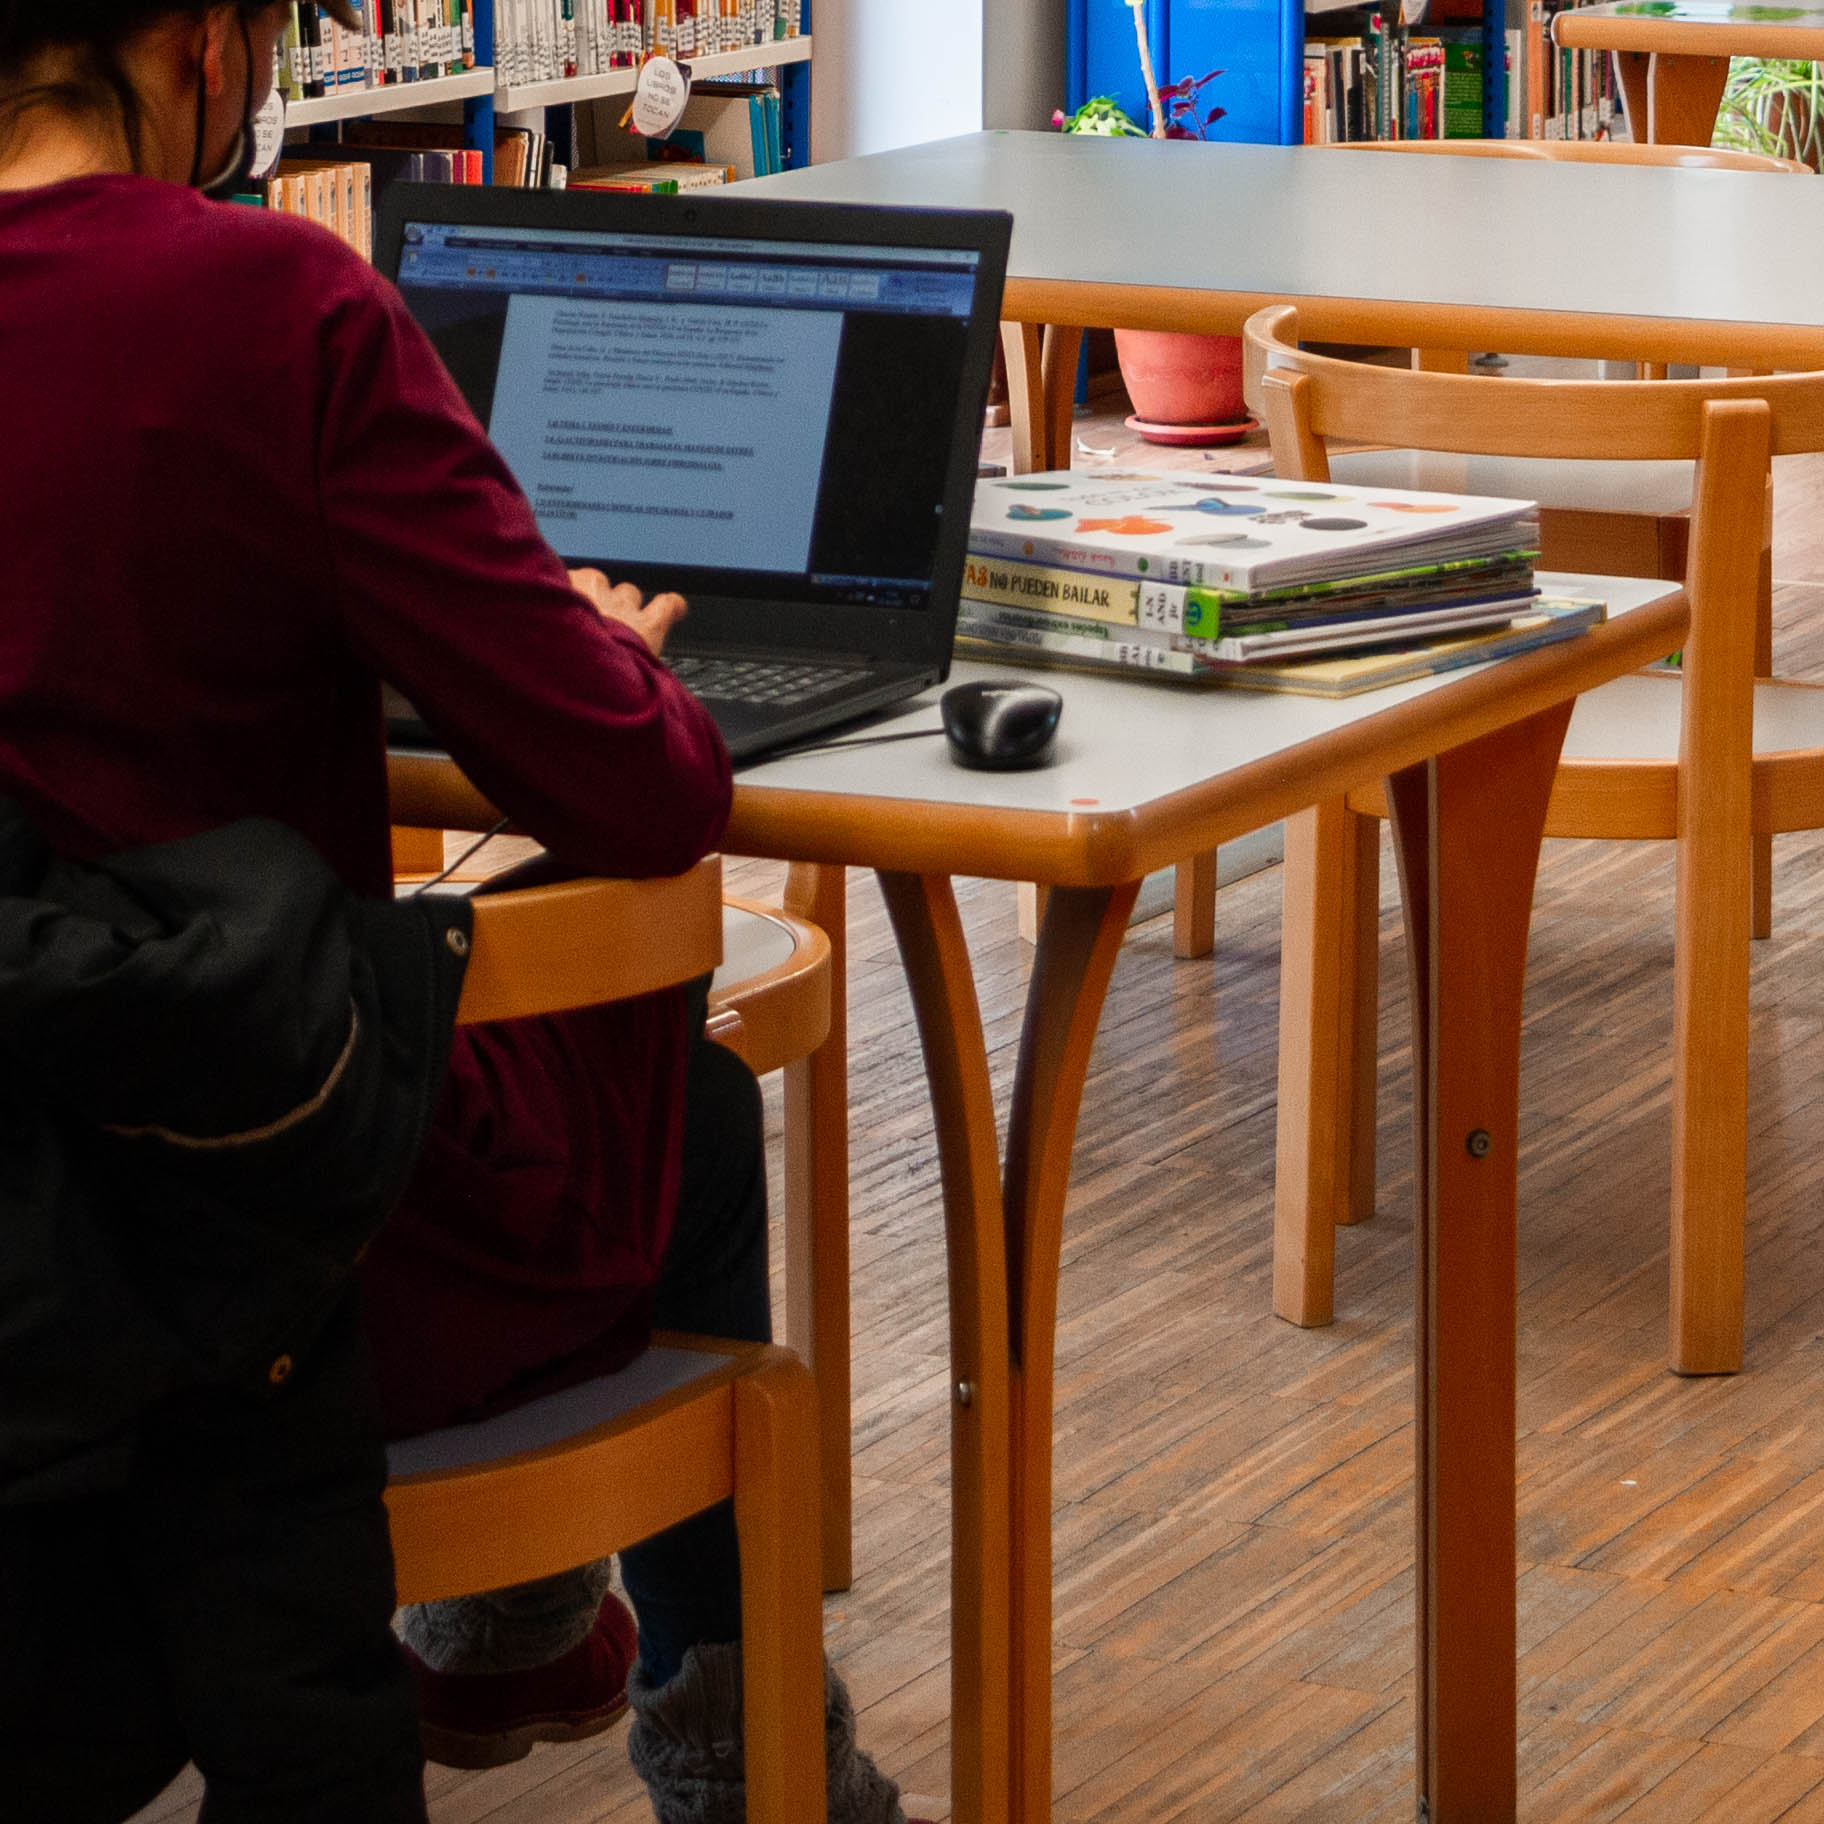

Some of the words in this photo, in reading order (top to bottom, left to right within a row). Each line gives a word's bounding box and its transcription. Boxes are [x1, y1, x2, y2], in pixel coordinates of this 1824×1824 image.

[990, 571, 1008, 587] NO
[1011, 575, 1059, 600] PUEDEN
[1062, 583, 1109, 607] BAILAR
